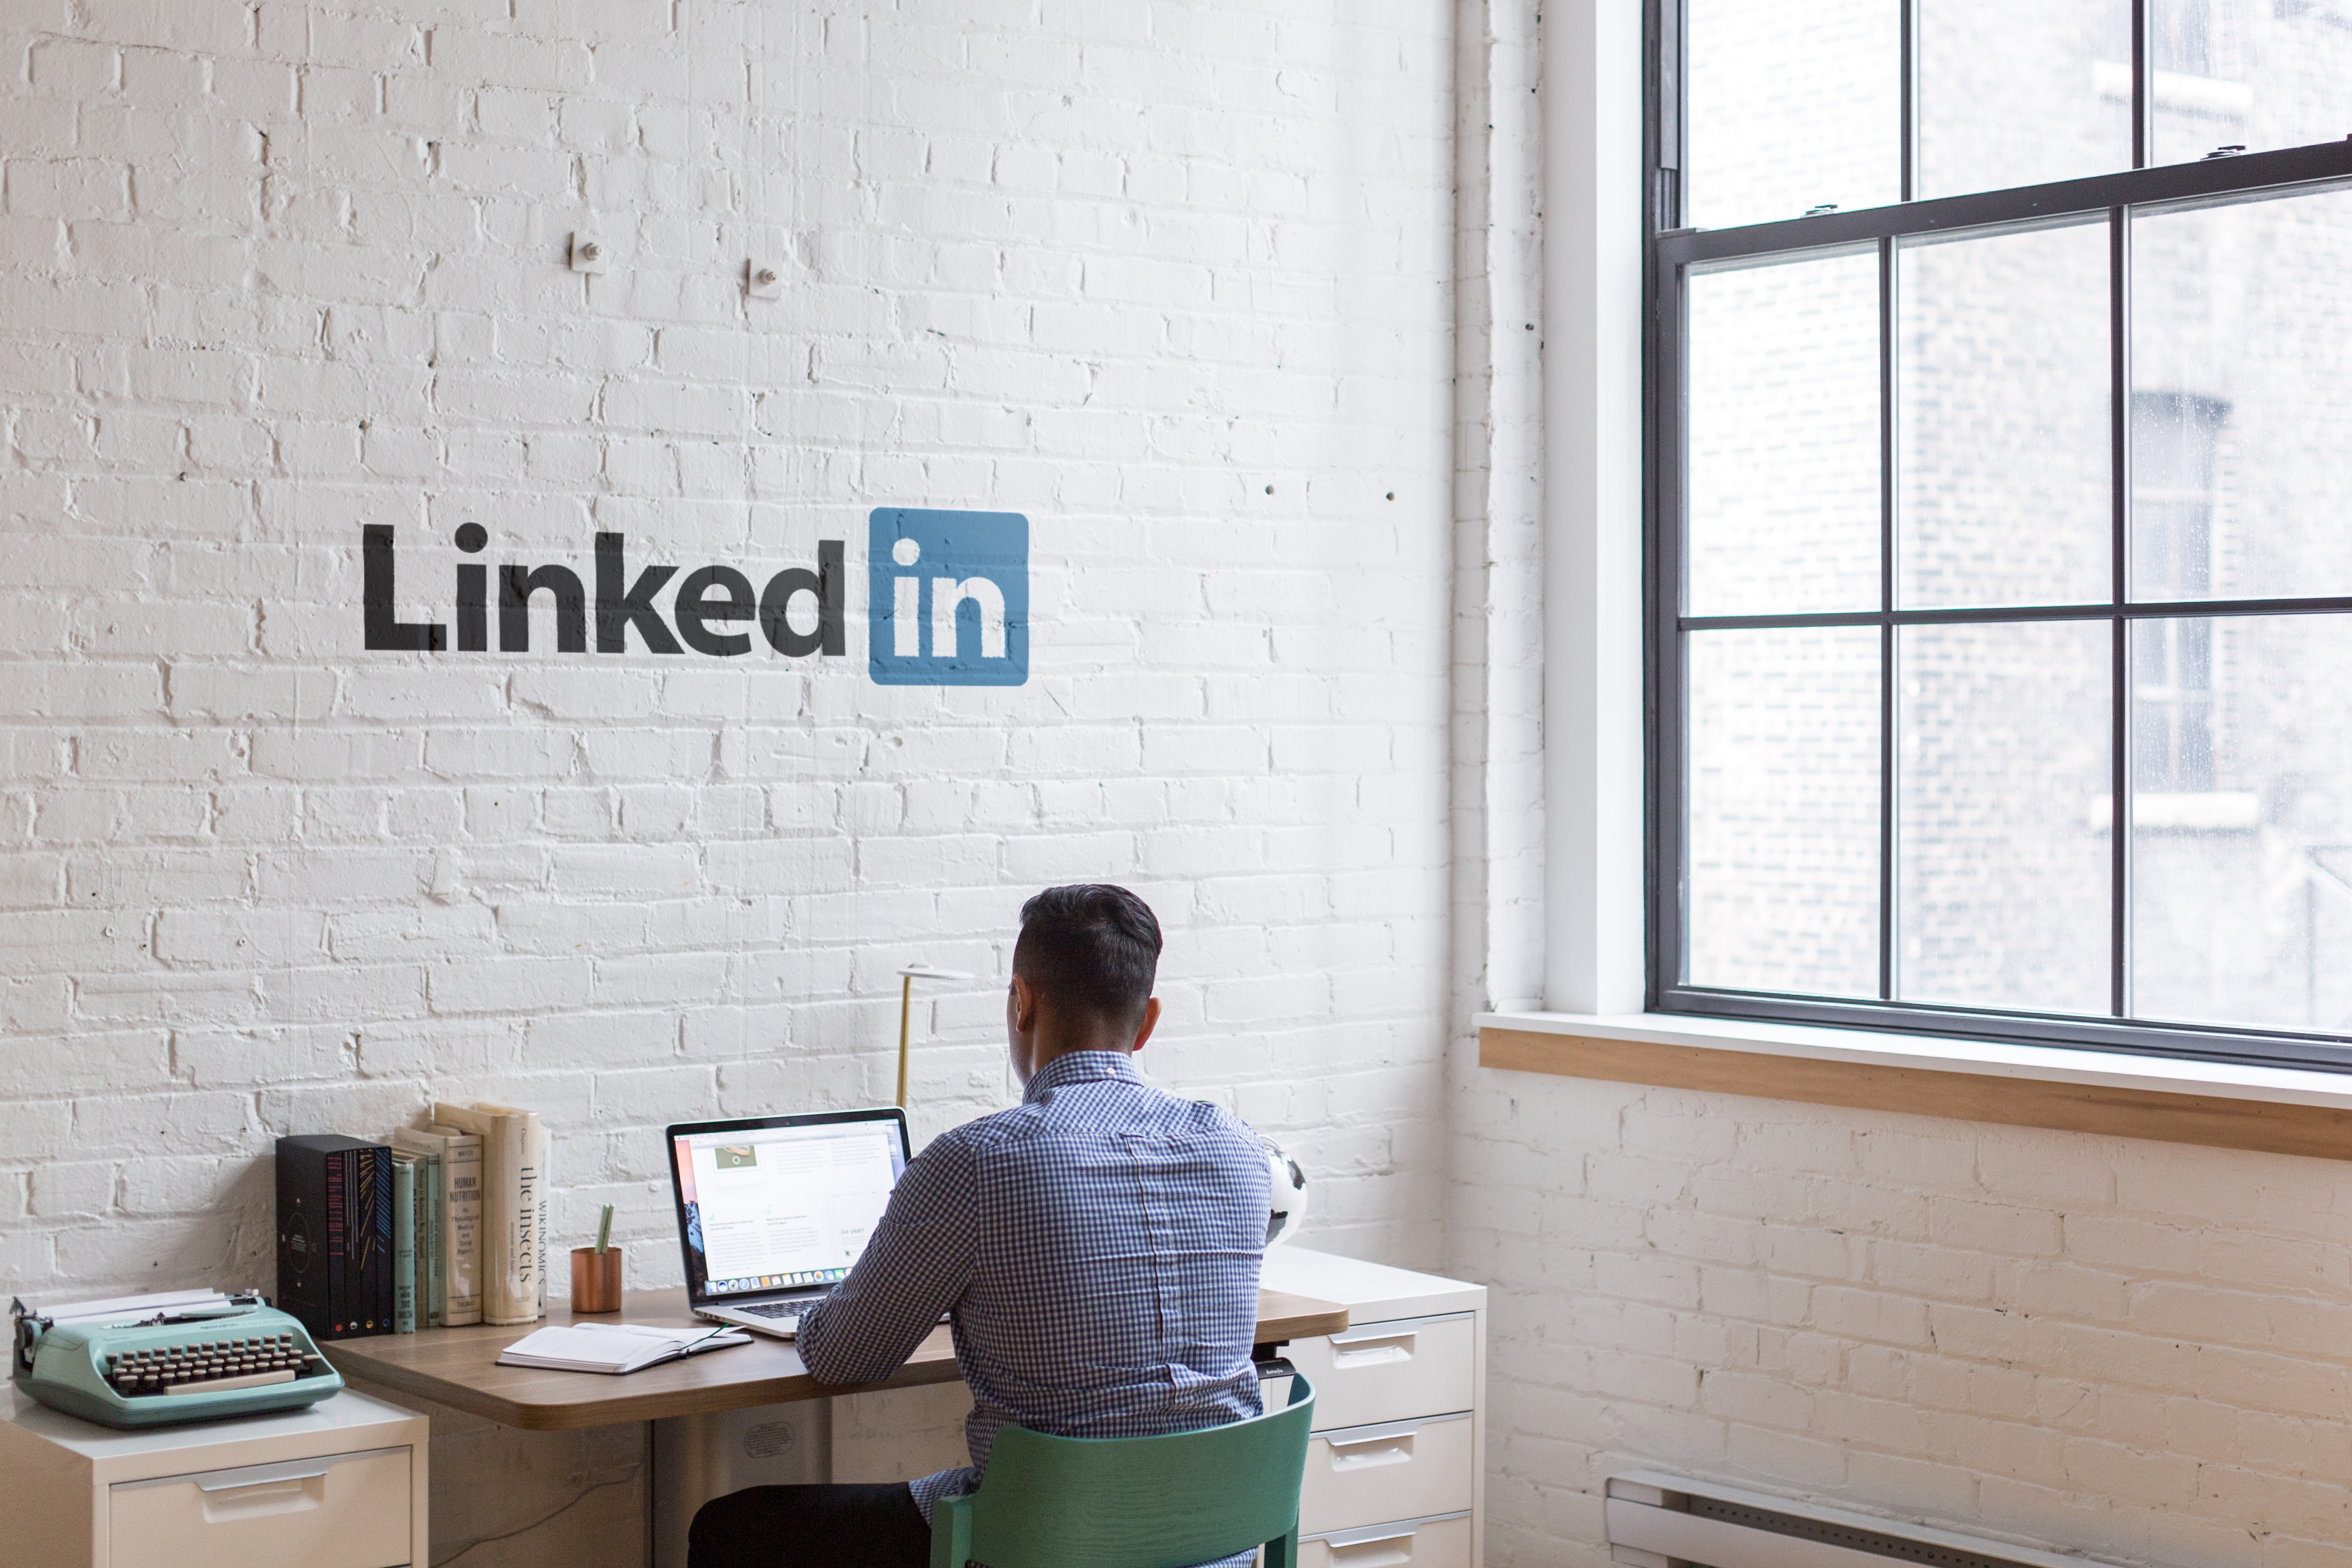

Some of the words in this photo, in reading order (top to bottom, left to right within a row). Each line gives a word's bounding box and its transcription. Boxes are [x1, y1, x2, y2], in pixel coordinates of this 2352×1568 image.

[363, 522, 845, 657] Linked
[893, 538, 1006, 658] in
[450, 1190, 481, 1203] NUTRITION
[454, 1177, 476, 1189] HUMAN
[521, 1167, 537, 1202] the
[520, 1208, 534, 1283] insects
[538, 1200, 547, 1285] WIKINOMICS
[457, 1300, 476, 1308] THOMAS
